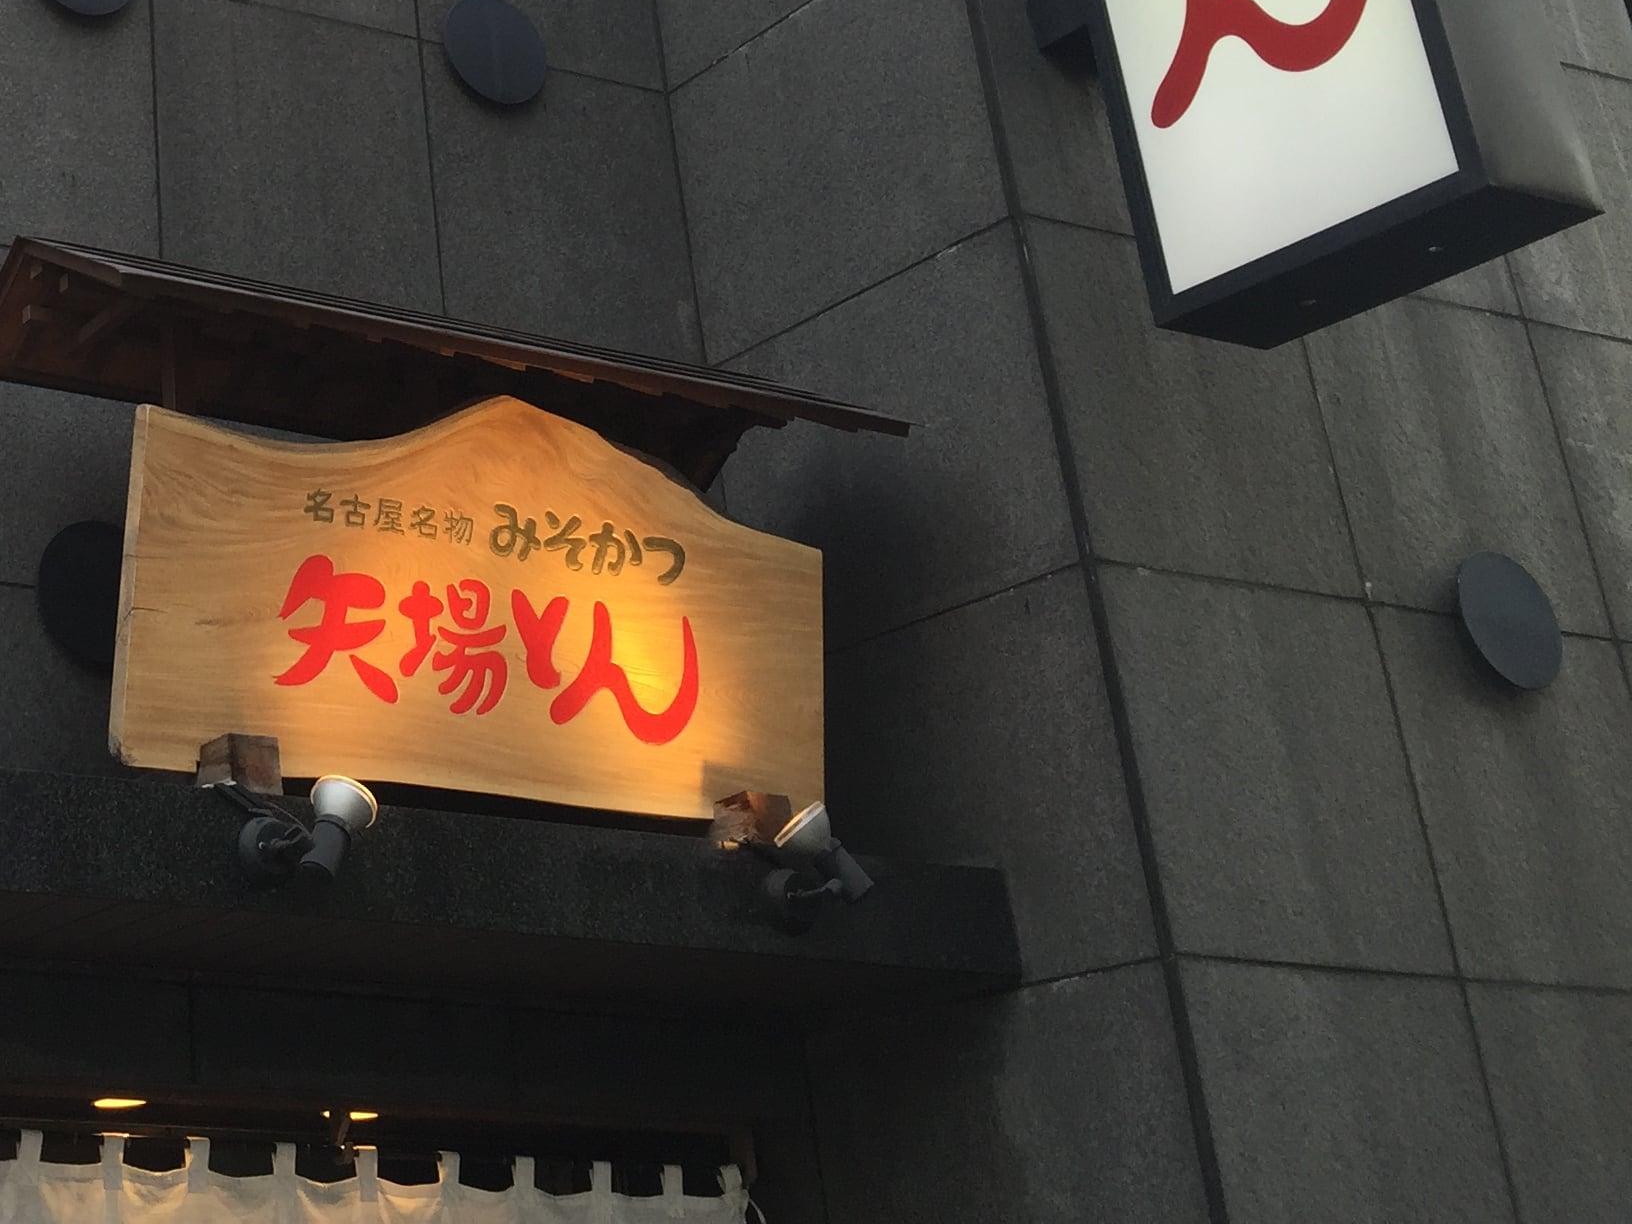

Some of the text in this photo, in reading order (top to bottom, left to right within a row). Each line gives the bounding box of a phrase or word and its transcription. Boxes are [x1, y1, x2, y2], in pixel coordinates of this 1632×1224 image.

[303, 487, 686, 586] 名古屋名物 みそかつ
[273, 553, 700, 746] 矢場とん
